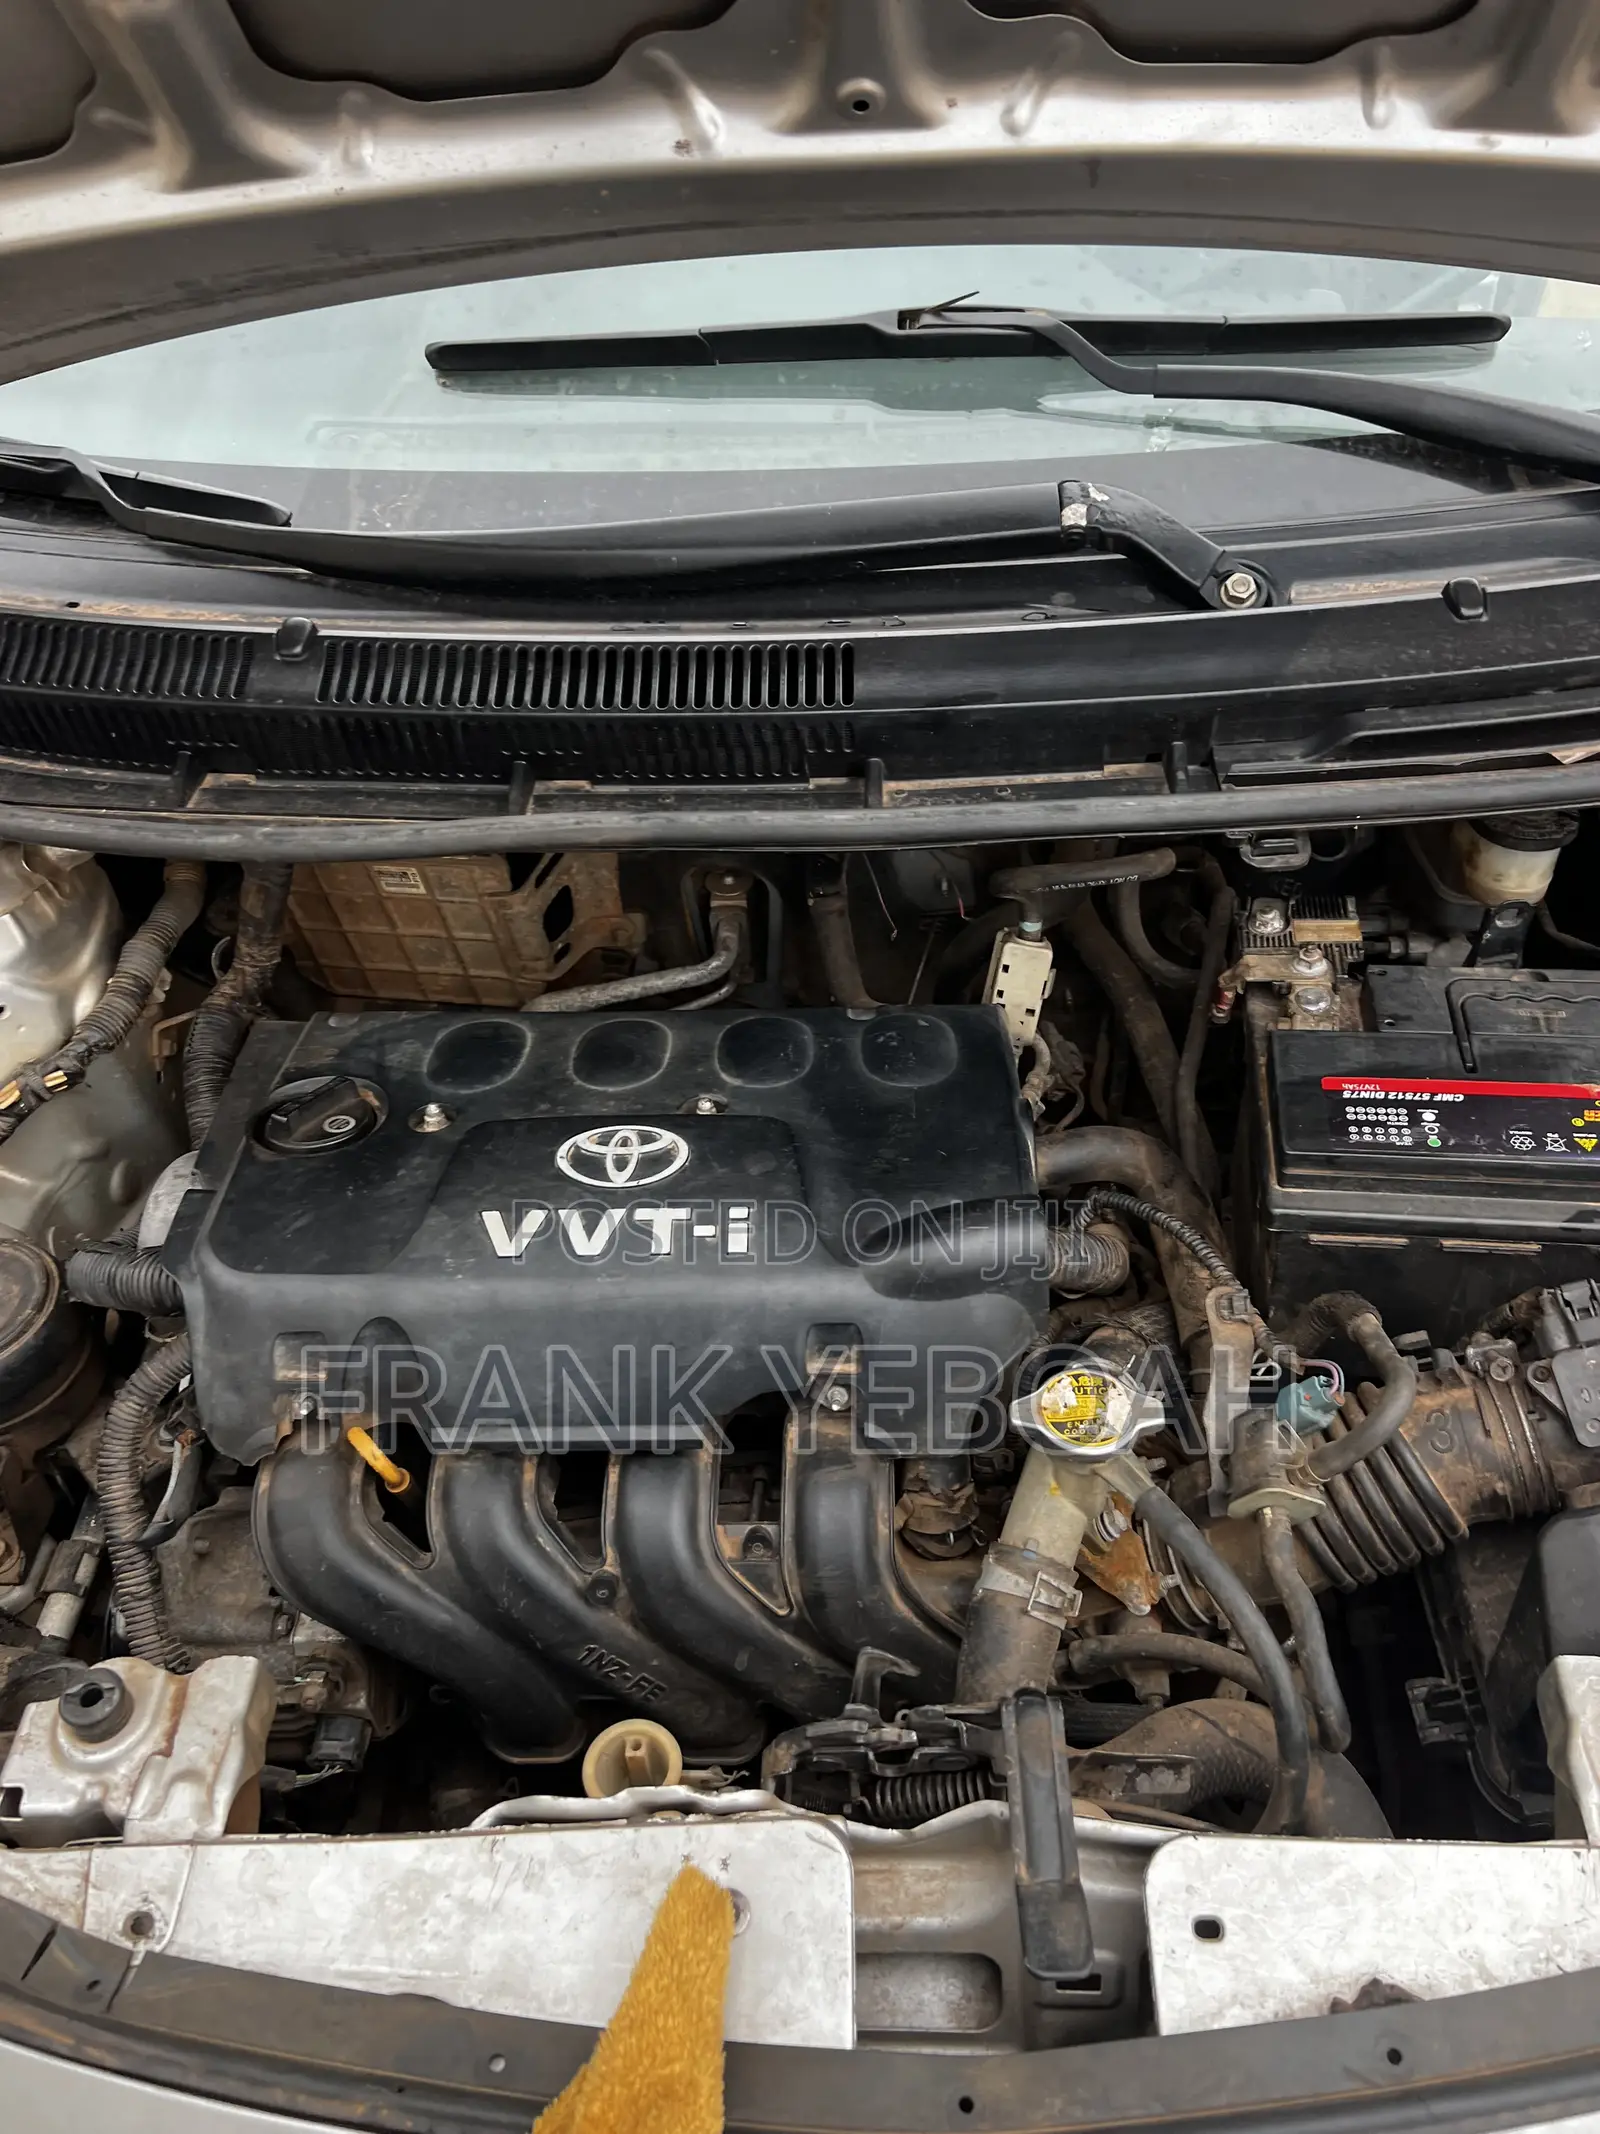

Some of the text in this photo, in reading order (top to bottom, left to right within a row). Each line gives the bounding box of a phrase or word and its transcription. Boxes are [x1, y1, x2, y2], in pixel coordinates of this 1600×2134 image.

[1342, 1090, 1465, 1102] CMF 57512 DIN75
[479, 1206, 750, 1257] VVT-i
[1427, 1408, 1455, 1454] 3
[577, 1644, 668, 1701] 1NZ-FE
